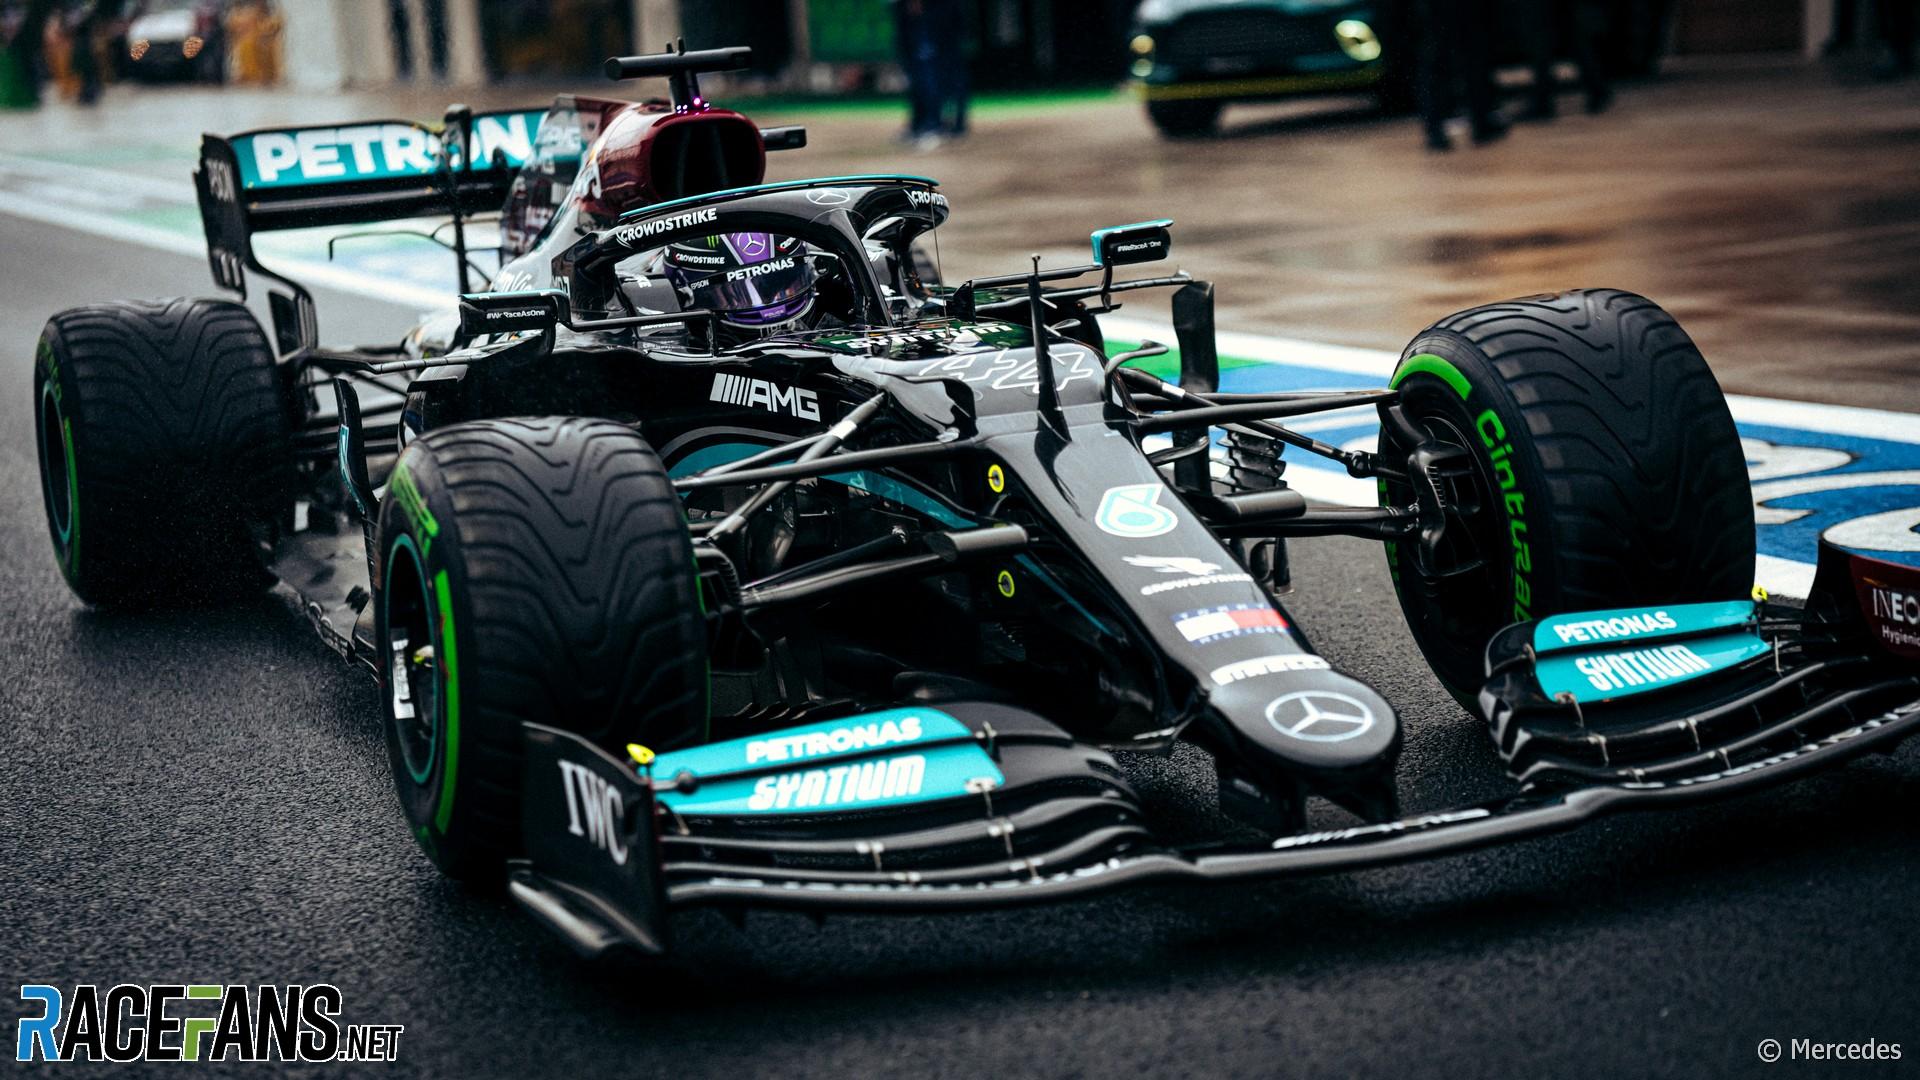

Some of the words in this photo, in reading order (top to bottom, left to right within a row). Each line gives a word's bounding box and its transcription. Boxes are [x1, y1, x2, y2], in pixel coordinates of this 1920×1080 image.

[619, 208, 718, 243] CROWDSTRIKE
[675, 253, 725, 265] CROWDSTRIKE
[726, 257, 795, 283] PETRONAS
[690, 279, 710, 290] EPSON
[747, 378, 821, 422] AMG
[1553, 611, 1678, 643] PETRONAS
[1575, 644, 1713, 691] SYNTIUM
[746, 716, 923, 764] PETRONAS
[747, 754, 927, 810] SYNTIUM
[558, 759, 628, 866] IWC
